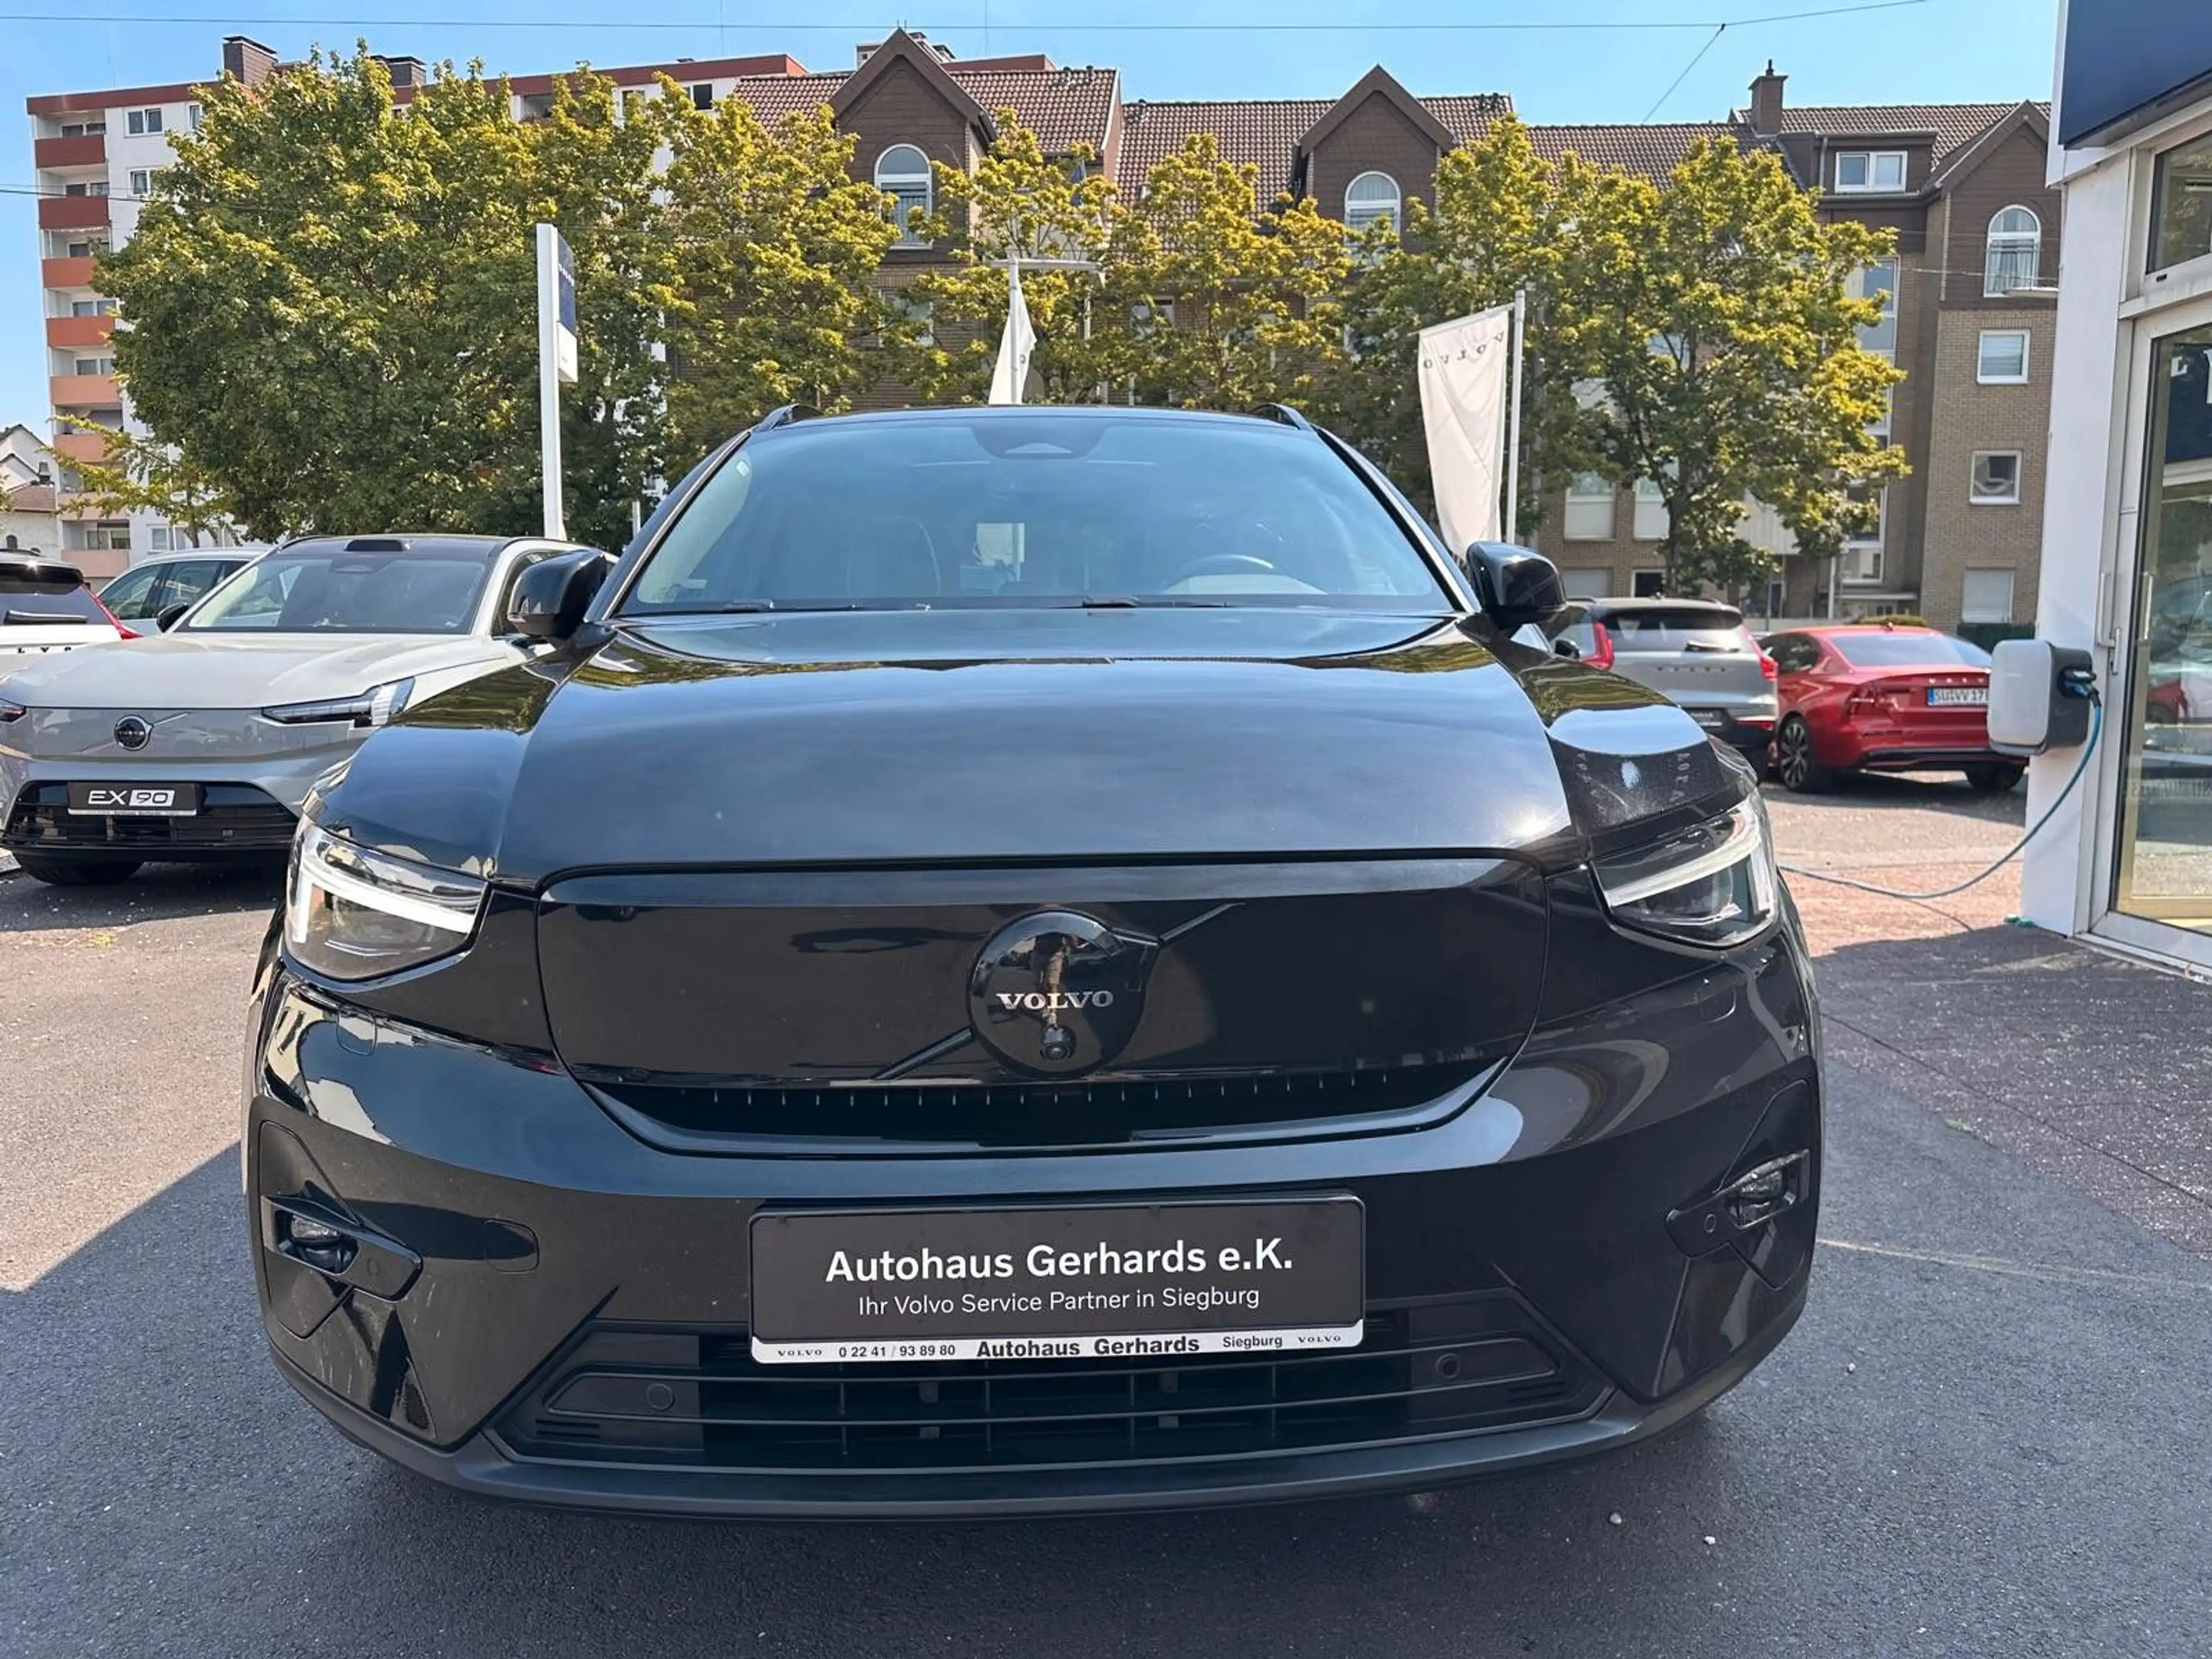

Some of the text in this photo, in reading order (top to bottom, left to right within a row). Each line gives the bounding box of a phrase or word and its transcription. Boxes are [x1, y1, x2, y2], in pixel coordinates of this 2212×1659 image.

[995, 990, 1114, 1011] VOLVO
[825, 1237, 1293, 1283] Autohaus Gerhards e.K.
[859, 1286, 1260, 1316] Ihr Volvo Service Partner in Siegburg
[778, 1349, 823, 1357] VOLVO
[839, 1346, 847, 1357] 0
[851, 1346, 867, 1357] 22
[870, 1346, 886, 1357] 41
[899, 1345, 916, 1357] 93
[919, 1345, 935, 1356] 89
[940, 1344, 956, 1355] 80
[976, 1340, 1081, 1357] Autohaus
[1094, 1335, 1200, 1355] Gerhards
[1223, 1335, 1283, 1350] Siegburg
[1298, 1335, 1342, 1343] VOLVO
